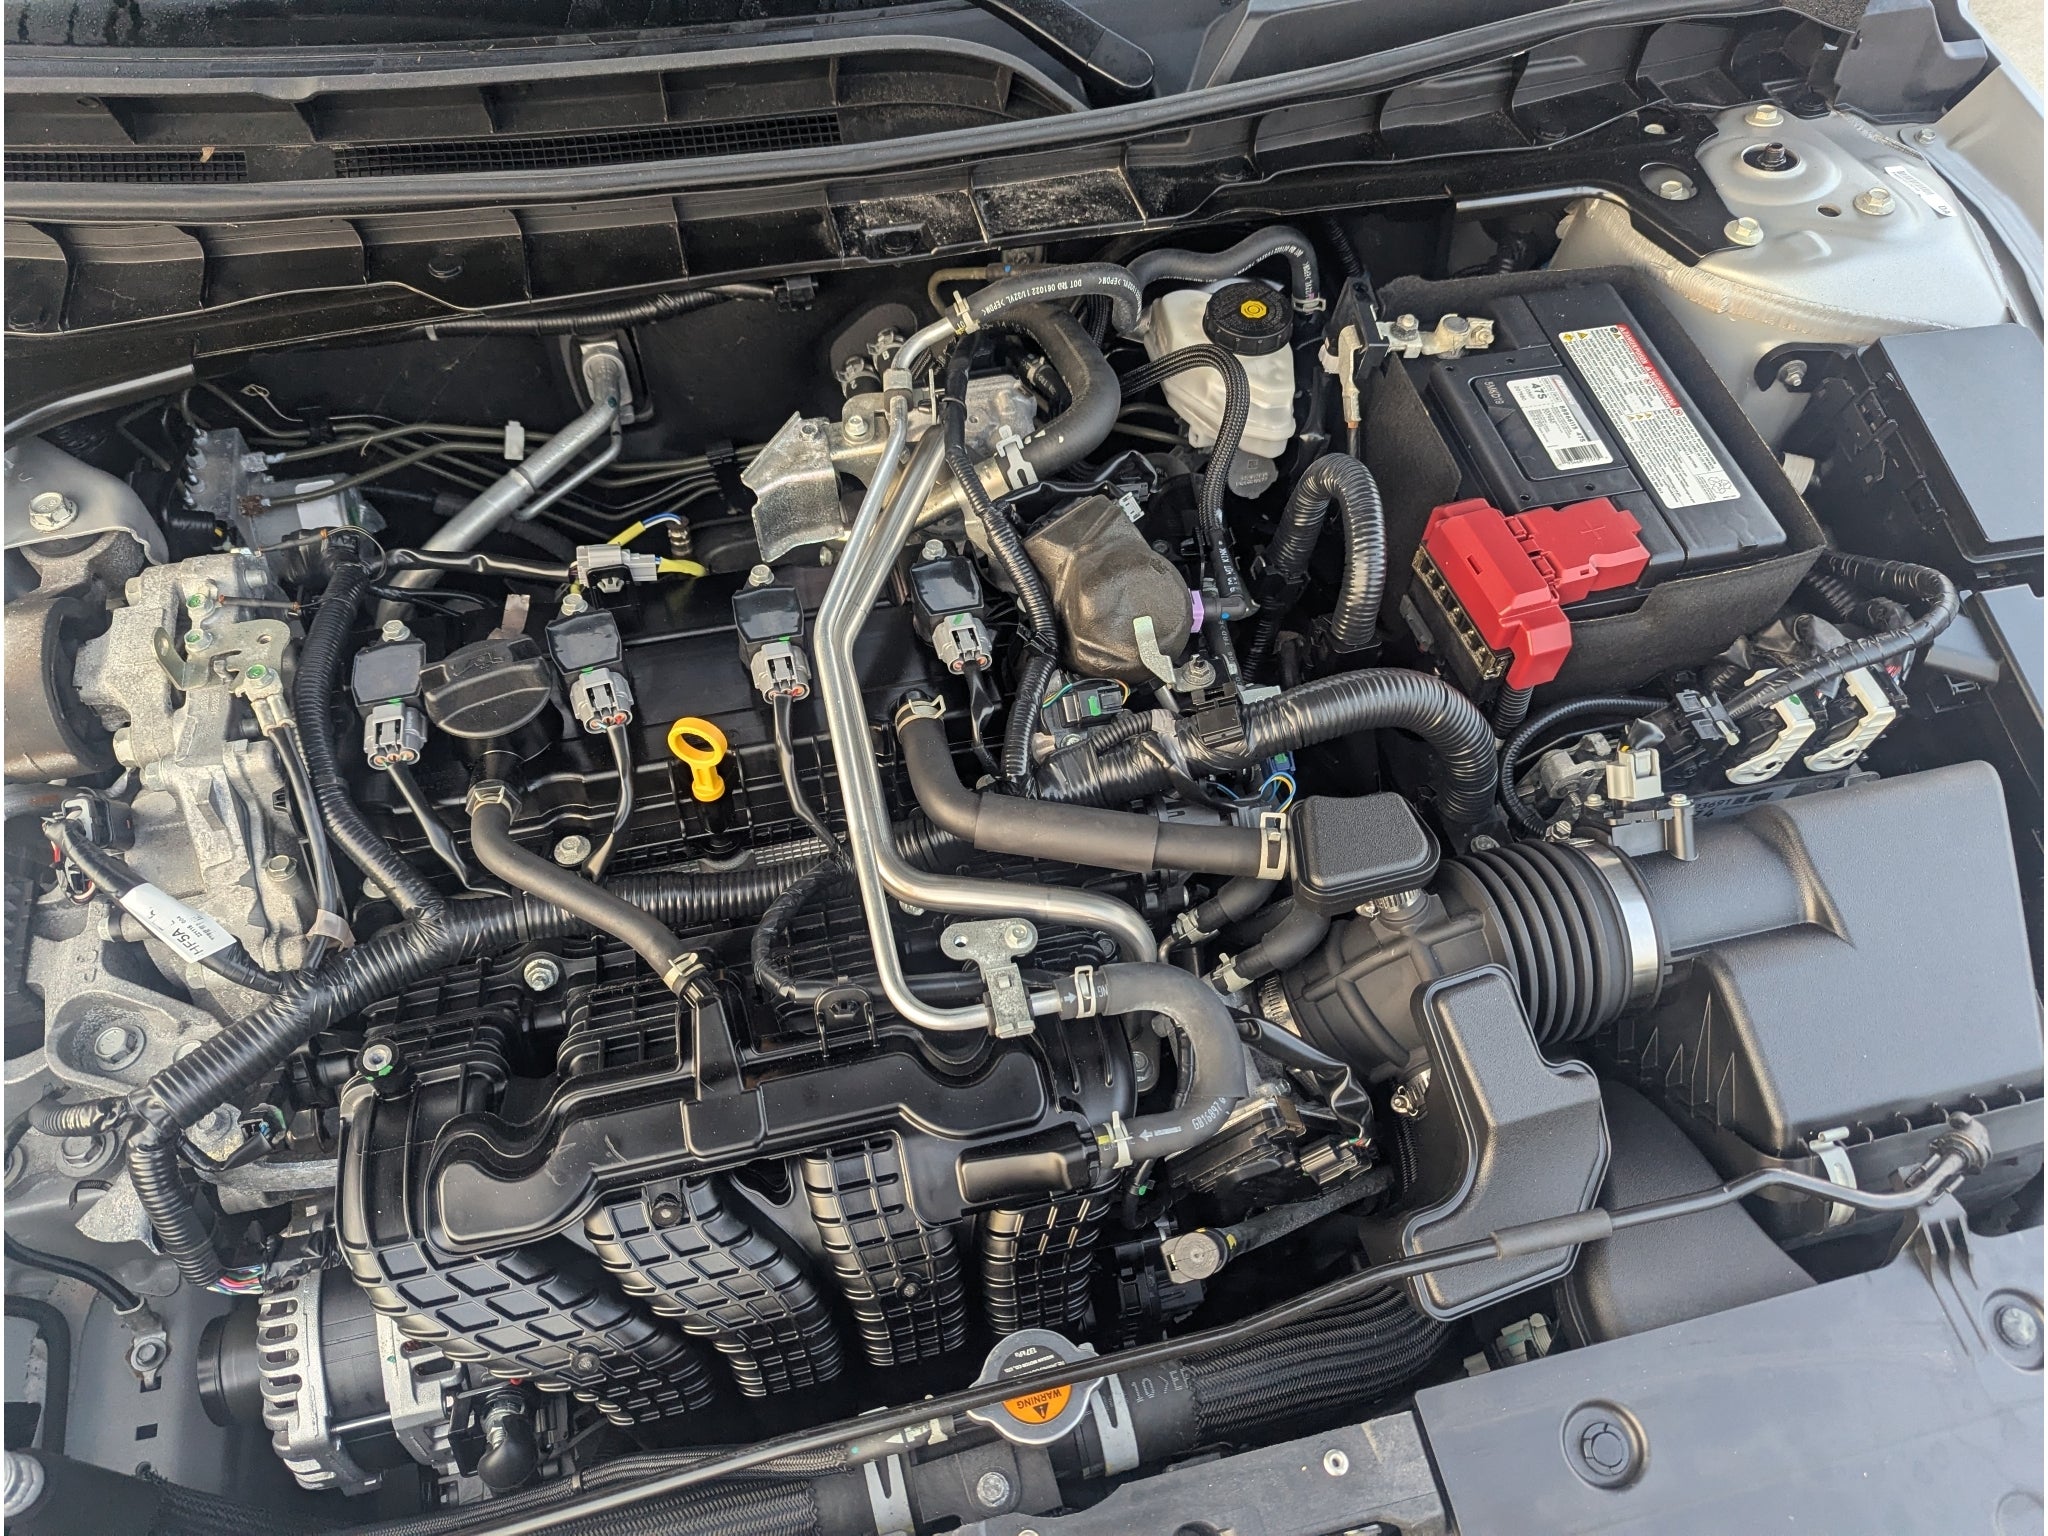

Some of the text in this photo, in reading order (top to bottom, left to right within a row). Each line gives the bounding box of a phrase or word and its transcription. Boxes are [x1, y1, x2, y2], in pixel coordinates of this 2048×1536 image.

[1032, 284, 1056, 296] 061022
[1070, 279, 1082, 288] DOT
[981, 299, 1006, 317] >EPDM<
[1531, 382, 1547, 400] 47S
[1219, 547, 1230, 563] KINK
[172, 928, 204, 955] HF5A
[1191, 1099, 1224, 1130] GB16897
[1016, 1389, 1062, 1410] WARNING
